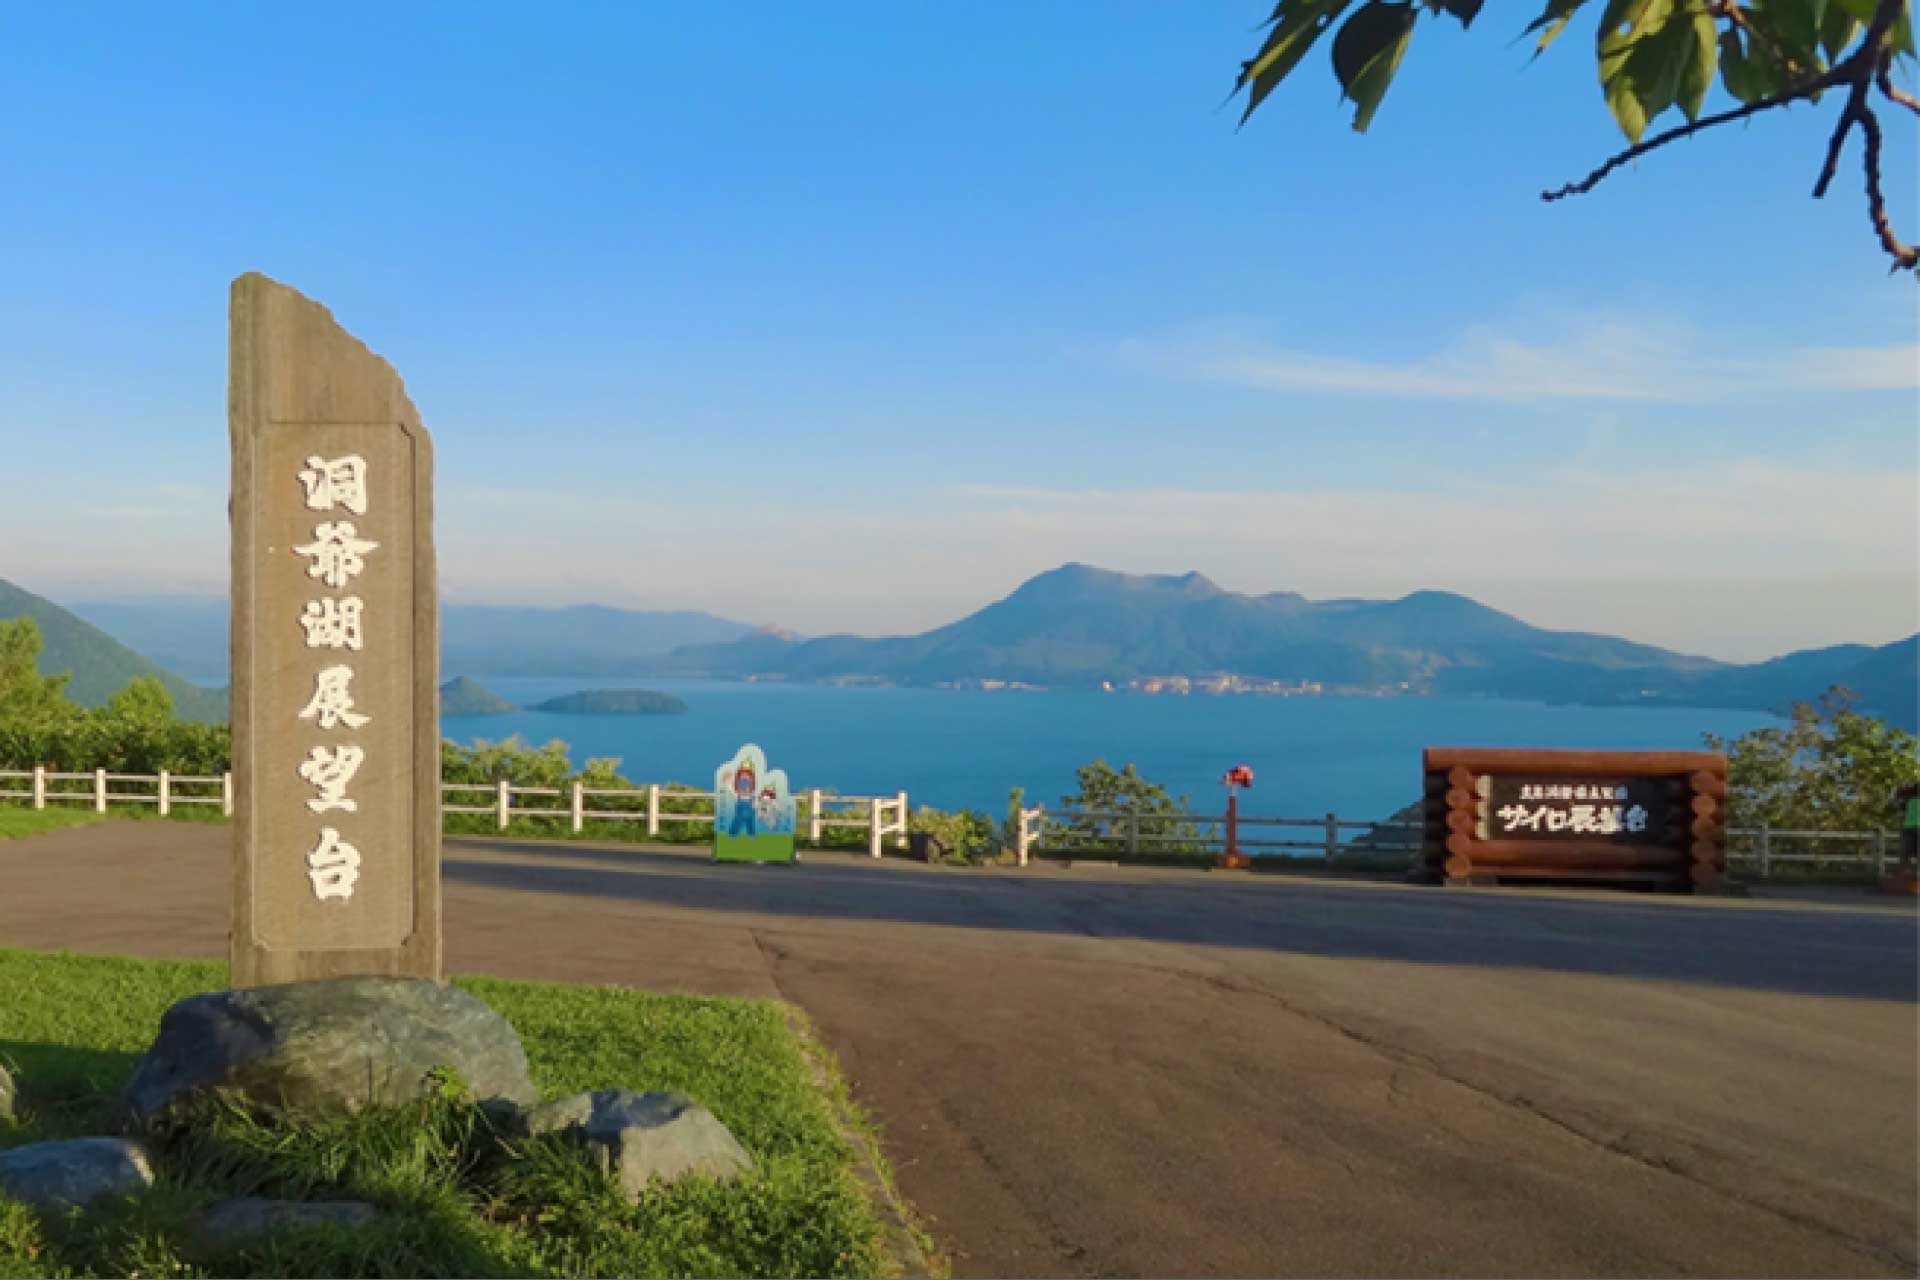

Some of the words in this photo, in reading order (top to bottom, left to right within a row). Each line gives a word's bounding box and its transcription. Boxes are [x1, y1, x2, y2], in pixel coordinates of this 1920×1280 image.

[294, 453, 379, 901] 洞爺湖展望台
